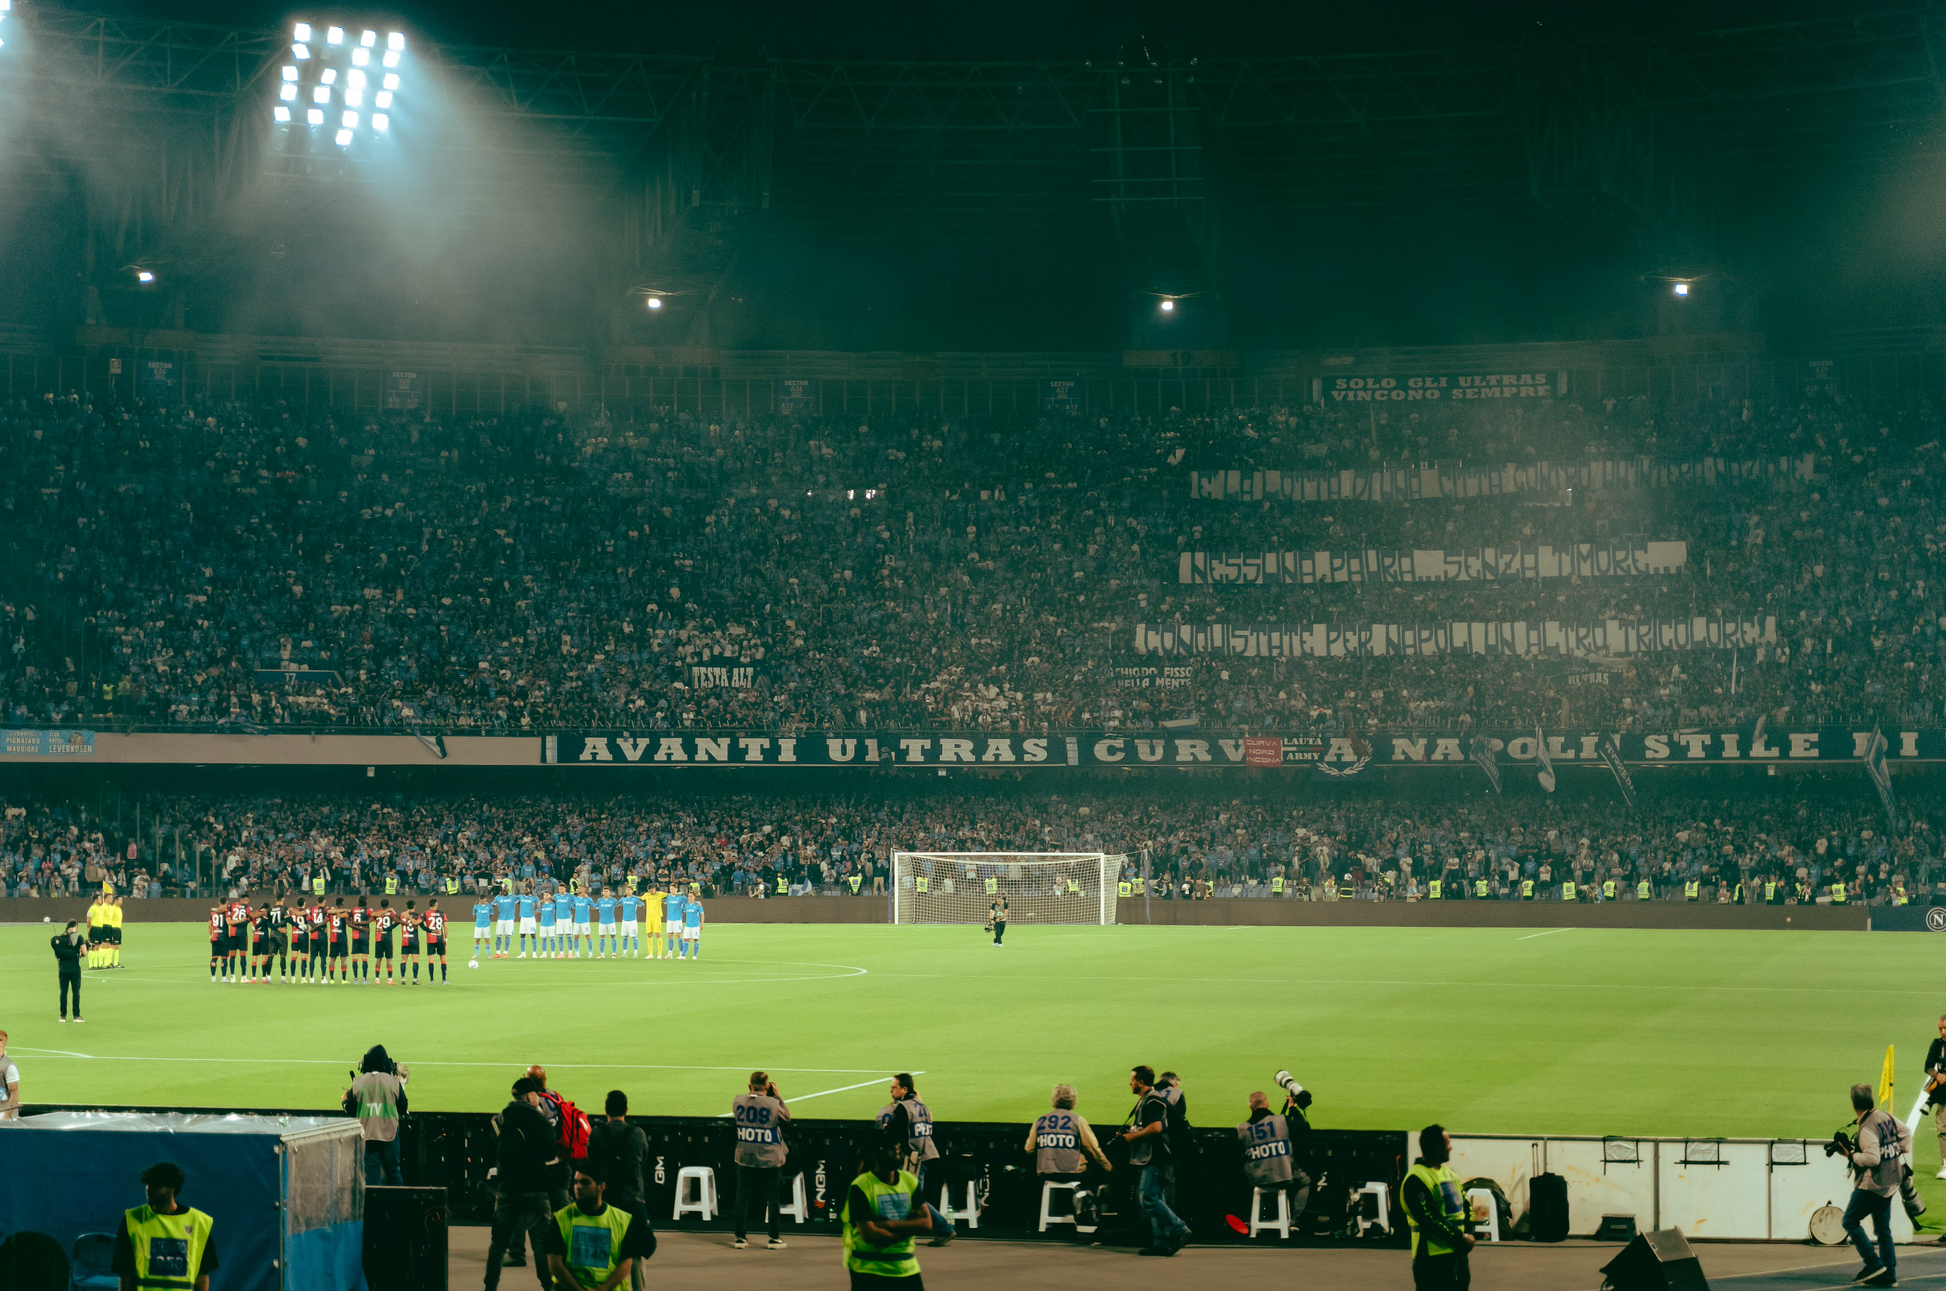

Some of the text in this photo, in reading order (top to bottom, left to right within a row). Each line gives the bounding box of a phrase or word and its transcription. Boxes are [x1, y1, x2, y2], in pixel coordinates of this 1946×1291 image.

[1336, 373, 1547, 389] SOLO GLI ULTRAS
[1331, 385, 1551, 401] VINCONO SEMPRE
[1190, 552, 1315, 583] NESSUNA
[1144, 624, 1314, 656] CONQUISTATE
[1326, 625, 1374, 656] PER
[1383, 622, 1473, 656] NAPOLI
[1484, 622, 1514, 655] UN
[1524, 621, 1608, 655] ALTRO
[691, 667, 729, 688] TESTA
[1115, 666, 1192, 678] CHIODO FISSO
[1156, 677, 1191, 689] MENTE
[1283, 737, 1323, 745] LAUTA
[49, 745, 92, 753] LEVERKUSEN
[579, 737, 796, 762] AVANTI
[1093, 738, 1247, 762] CURV
[1645, 734, 1818, 759] STILE
[1286, 753, 1321, 761] ARMY
[212, 914, 224, 927] 91
[232, 908, 247, 921] 26
[270, 911, 281, 924] 71
[313, 912, 323, 924] 14
[332, 914, 341, 927] 8
[1933, 914, 1944, 926] N
[376, 917, 391, 929] 29
[428, 917, 443, 930] 28
[367, 1103, 382, 1116] TV
[736, 1104, 770, 1124] 209
[1038, 1115, 1072, 1131] 292
[737, 1128, 772, 1142] HOTO
[1247, 1121, 1276, 1143] 151
[574, 1231, 607, 1244] STEWARD
[573, 1246, 606, 1260] 1140
